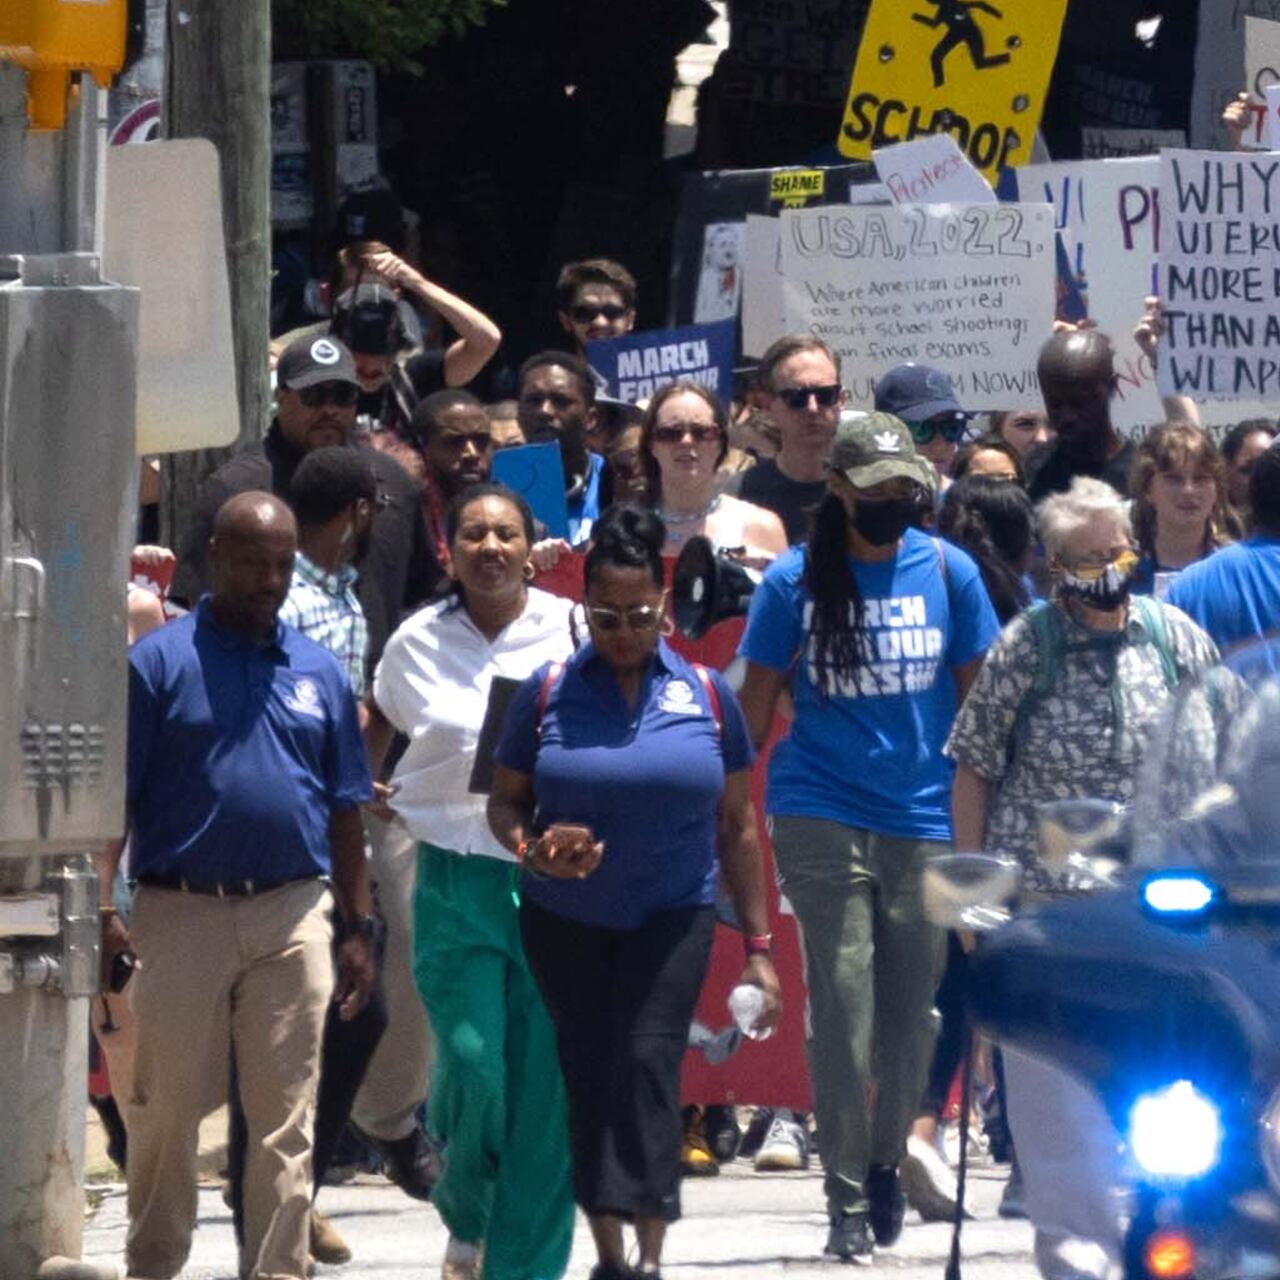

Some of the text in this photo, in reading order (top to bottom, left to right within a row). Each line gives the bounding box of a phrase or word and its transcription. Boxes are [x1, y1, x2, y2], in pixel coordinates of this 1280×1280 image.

[771, 172, 822, 194] SHAME
[1171, 158, 1279, 214] WHY
[907, 205, 1044, 259] 2022:
[805, 279, 864, 304] Where
[868, 280, 947, 297] American
[1168, 264, 1265, 302] MORE
[851, 301, 903, 318] more
[911, 290, 1004, 317] worried
[1161, 309, 1254, 350] THAN
[616, 339, 710, 380] MARCH
[868, 339, 992, 361] final exams
[803, 594, 926, 631] MRCH
[877, 628, 942, 661] OUR
